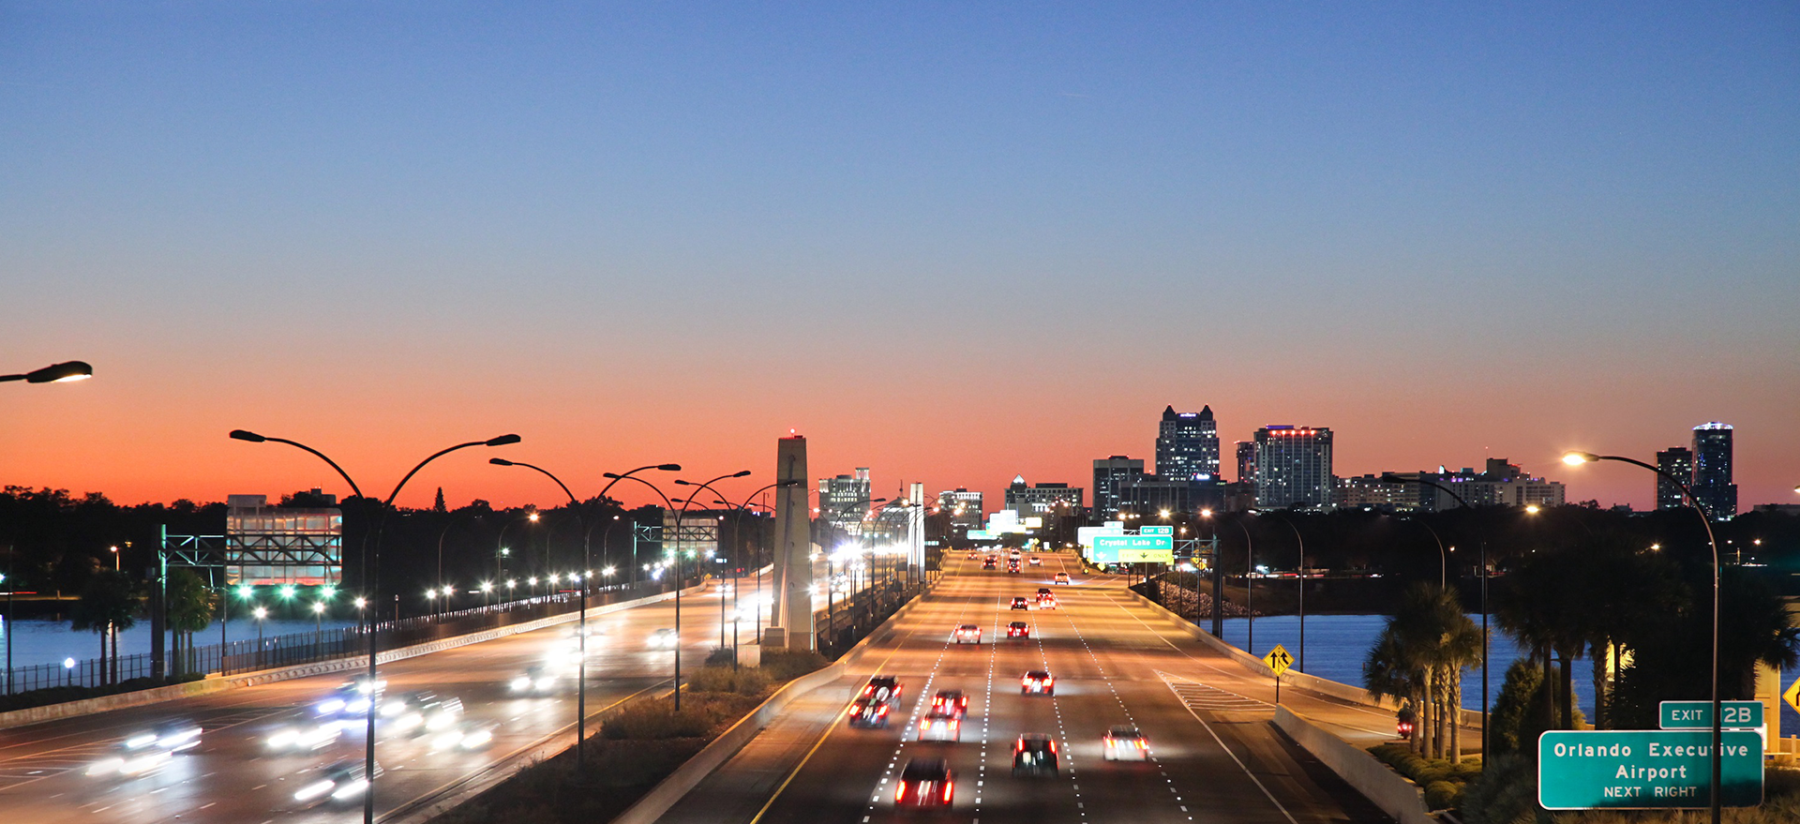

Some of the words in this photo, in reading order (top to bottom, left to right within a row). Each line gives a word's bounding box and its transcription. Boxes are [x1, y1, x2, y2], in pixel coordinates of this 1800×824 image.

[1099, 539, 1127, 547] Crystal
[1671, 709, 1703, 721] EXIT
[1720, 707, 1752, 723] 2B
[1554, 742, 1632, 757] Orlando
[1648, 742, 1749, 757] Execuive
[1615, 764, 1687, 782] Airport
[1604, 786, 1641, 798] NEXT
[1654, 786, 1697, 798] RIGHT
